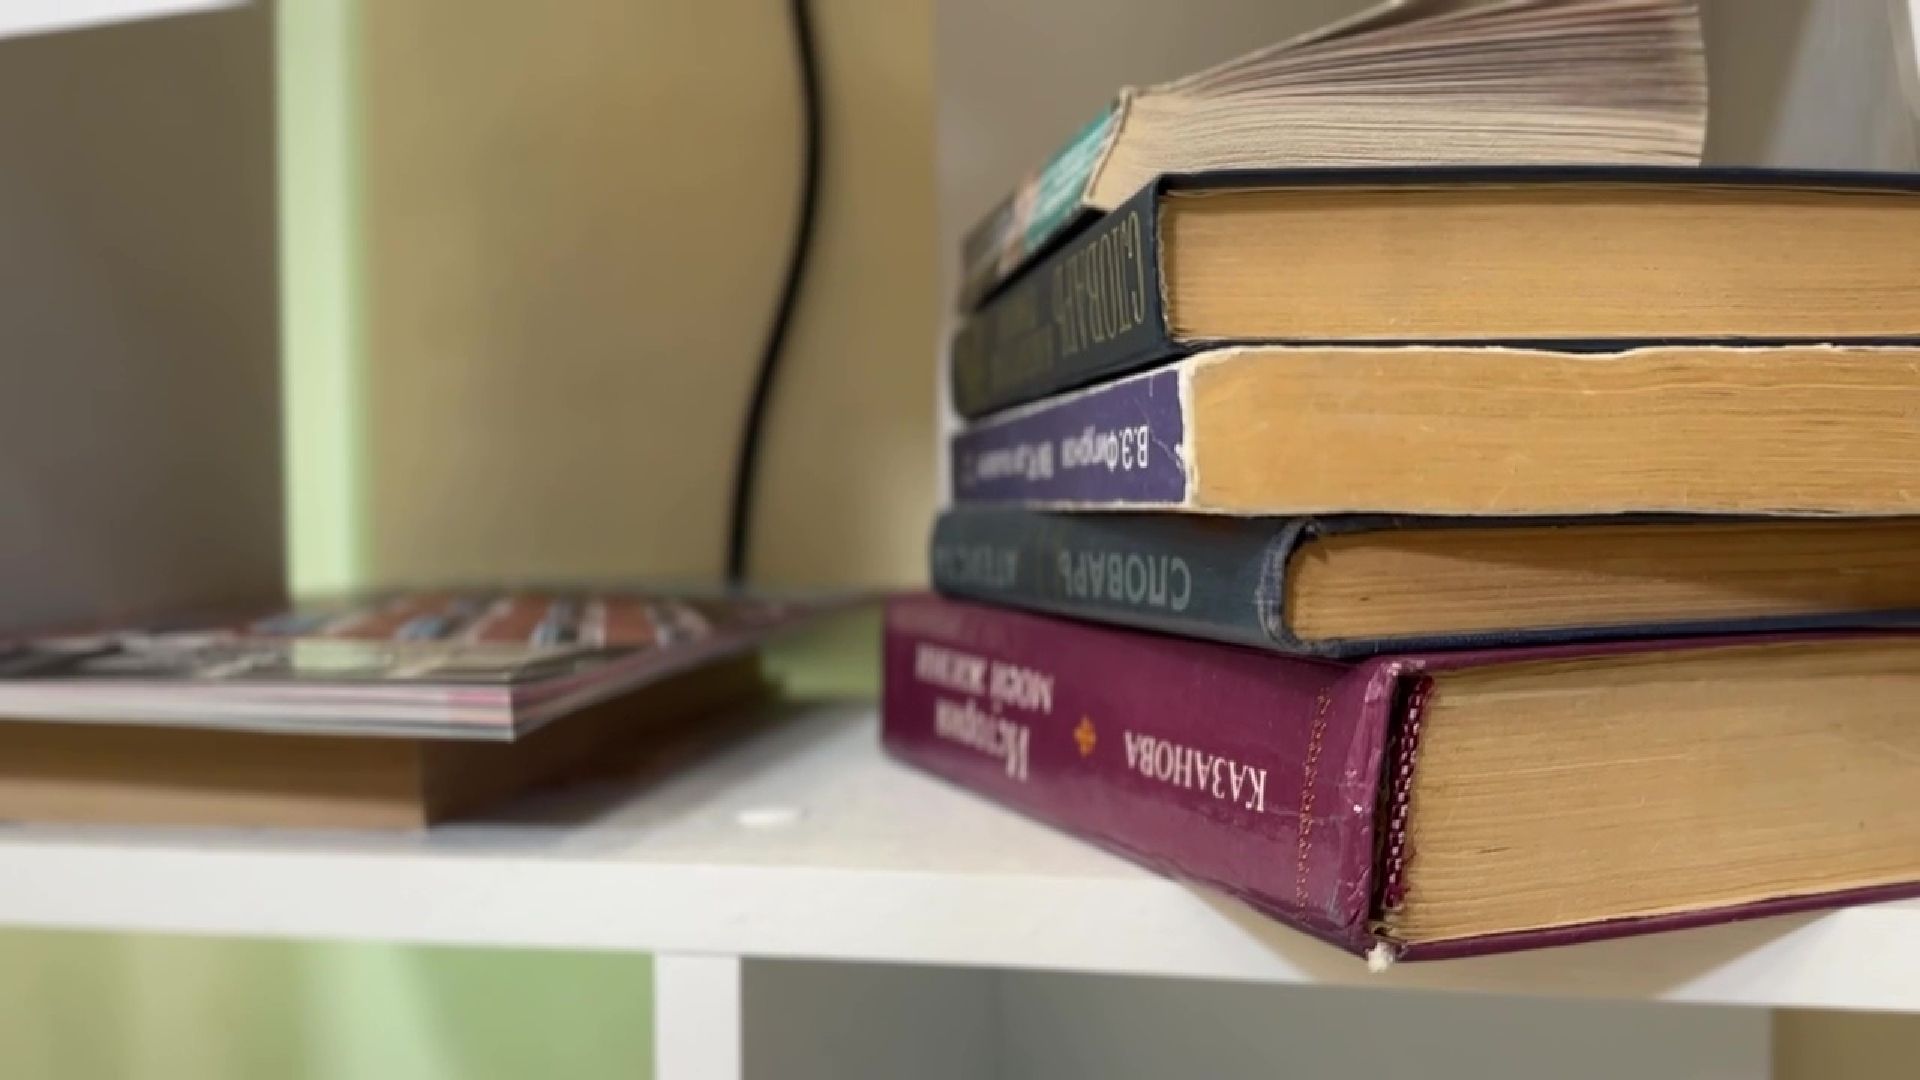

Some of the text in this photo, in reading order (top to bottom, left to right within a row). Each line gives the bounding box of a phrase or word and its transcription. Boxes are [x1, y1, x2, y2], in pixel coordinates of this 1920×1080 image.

[1053, 211, 1145, 357] СЛОВАРЬ
[1062, 549, 1192, 611] СЛОВАРЬ
[1125, 729, 1267, 812] КАЗАНОВА
